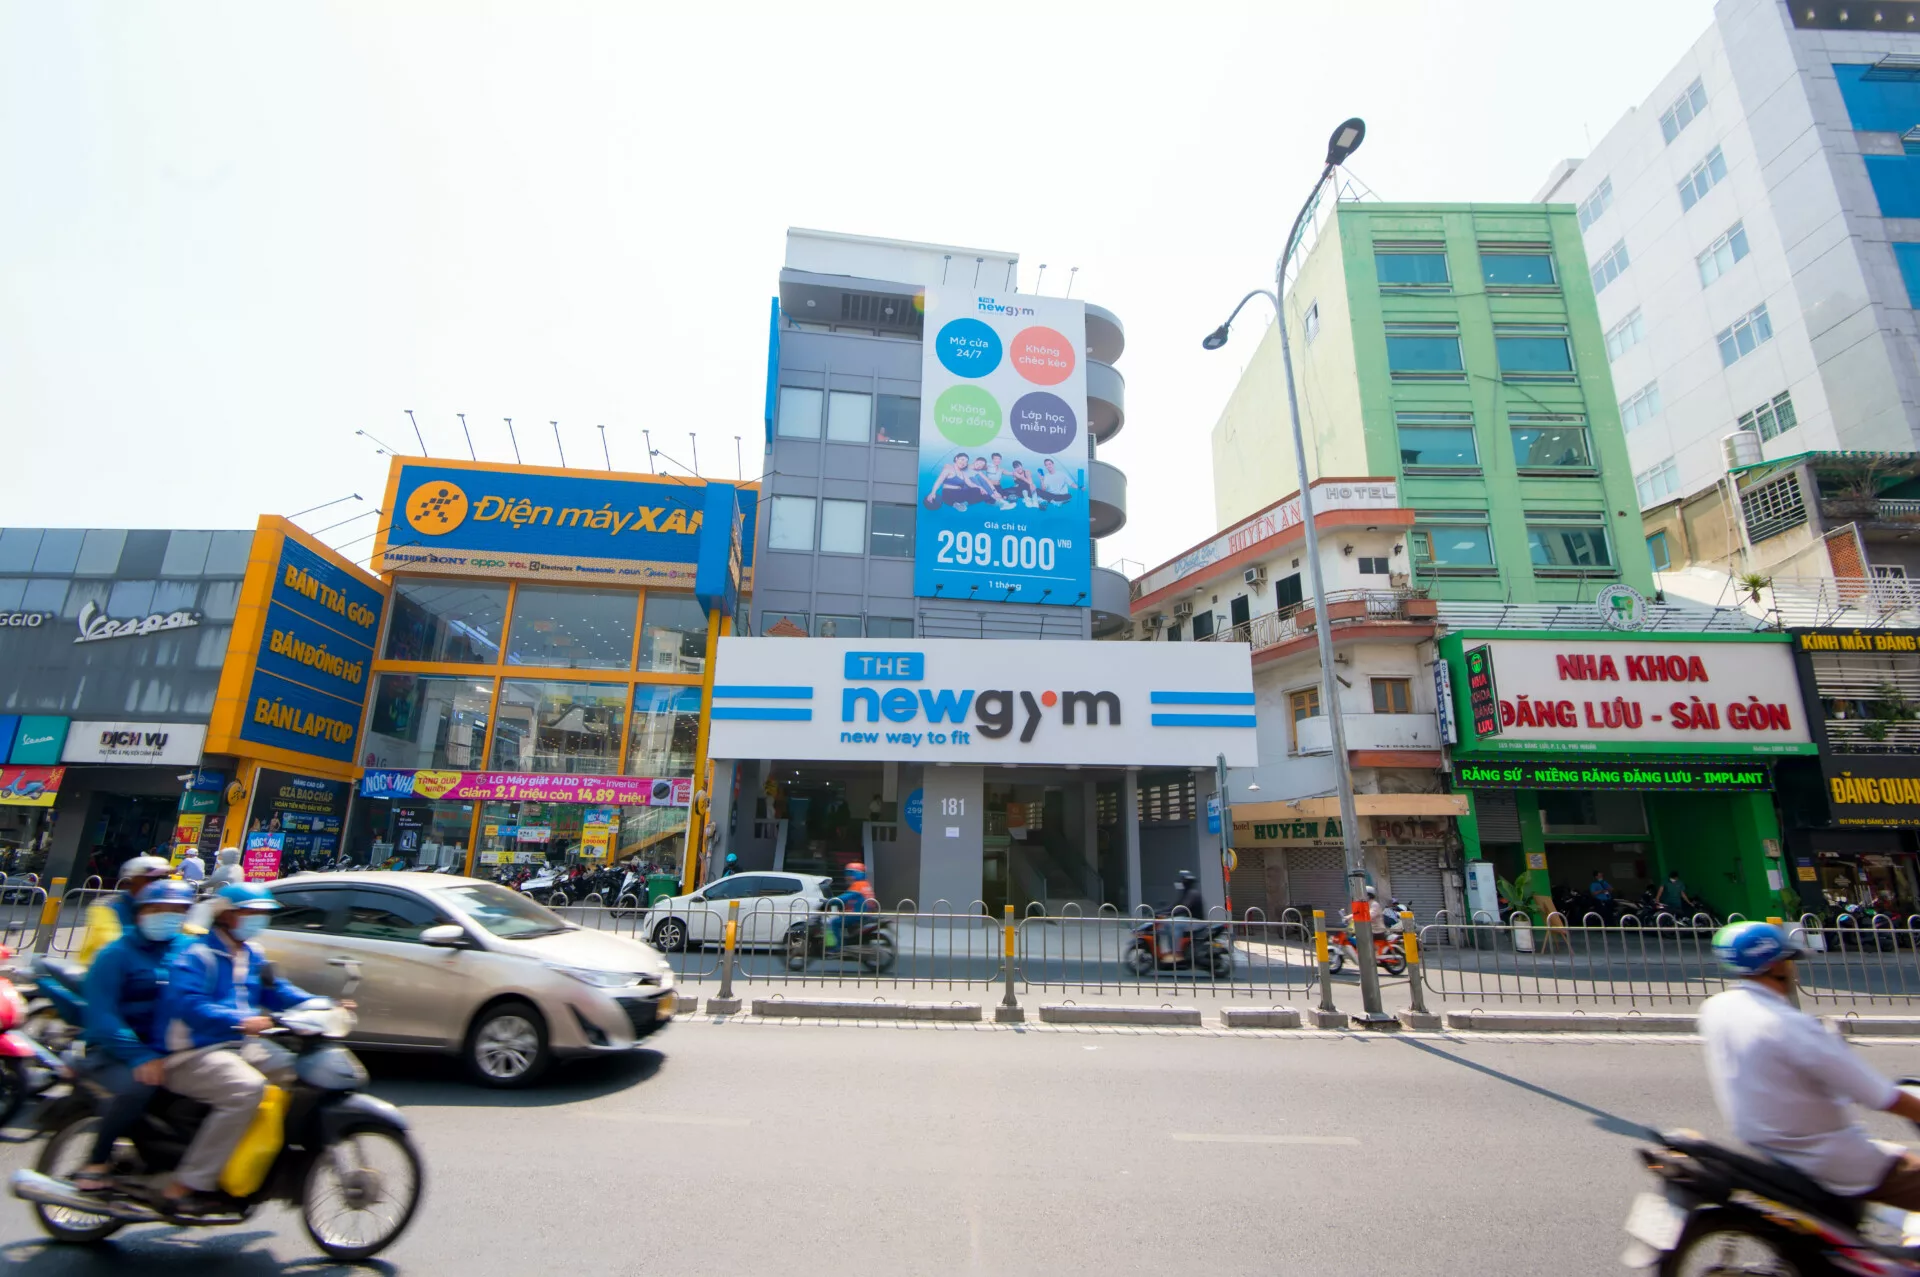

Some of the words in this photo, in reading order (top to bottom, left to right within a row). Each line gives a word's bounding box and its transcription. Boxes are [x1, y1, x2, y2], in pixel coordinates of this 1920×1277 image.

[950, 336, 966, 346] Mở
[969, 338, 989, 348] cửa
[1026, 344, 1060, 357] Không
[956, 348, 982, 359] 24/7
[950, 404, 986, 416] Không
[1022, 410, 1042, 421] Lớp
[1046, 412, 1065, 424] học
[1020, 421, 1047, 432] miễn
[1050, 424, 1066, 435] phí
[1326, 486, 1397, 500] HOTEL
[472, 494, 554, 530] Điện
[556, 503, 635, 536] máy
[629, 506, 704, 535] XA
[984, 521, 999, 530] Giá
[1002, 522, 1015, 530] chỉ
[937, 530, 1055, 571] 299.000
[1056, 538, 1072, 549] VNĐ
[384, 553, 428, 563] SAMSUNG
[429, 554, 468, 565] SONY
[470, 558, 506, 568] oppo
[541, 564, 573, 572] Electrolux
[576, 565, 616, 575] Panasonic
[618, 568, 640, 576] AQUA
[988, 580, 993, 588] 1
[994, 580, 1022, 592] tháng
[284, 564, 318, 600] BÁN
[320, 588, 348, 616] TRẢ
[348, 603, 375, 630] GÓP
[73, 600, 200, 643] Vespa
[269, 628, 304, 662] BÁN
[1800, 630, 1840, 650] KÍNH
[1840, 628, 1872, 650] MẮT
[1874, 632, 1917, 651] ĐĂNG
[858, 656, 911, 676] THE
[1556, 654, 1620, 682] NHA
[1625, 654, 1709, 682] KHOA
[1472, 674, 1488, 688] NHA
[1472, 688, 1491, 703] KHOA
[254, 696, 294, 730] BÁN
[292, 709, 354, 745] LAPTOP
[840, 686, 1122, 743] newgym
[1500, 694, 1578, 728] ĐĂNG
[1584, 696, 1644, 729] LƯU
[1669, 695, 1720, 730] SÀI
[1726, 695, 1792, 730] GÒN
[100, 731, 142, 748] DỊCH
[144, 732, 168, 750] VỤ
[840, 730, 880, 744] new
[885, 732, 923, 748] way
[927, 731, 948, 746] to
[950, 730, 970, 746] fit
[366, 772, 387, 792] NÓC
[489, 775, 502, 785] LG
[506, 776, 528, 786] Máy
[528, 776, 550, 787] giặt
[564, 777, 579, 786] DD
[606, 780, 639, 788] Inverter
[1462, 766, 1500, 781] RĂNG
[1503, 766, 1523, 781] SỨ
[1582, 768, 1621, 783] RĂNG
[1623, 768, 1662, 783] ĐĂNG
[1664, 770, 1692, 784] LƯU
[1704, 772, 1764, 784] IMPLANT
[459, 785, 490, 798] Giảm
[494, 785, 516, 799] 2,1
[519, 788, 548, 800] triệu
[549, 790, 572, 800] còn
[577, 788, 616, 803] 14,89
[618, 791, 647, 806] triệu
[1831, 771, 1880, 804] ĐĂNG
[940, 797, 966, 816] 181
[1233, 821, 1250, 831] hotel
[1324, 816, 1344, 838] Â
[251, 837, 264, 848] NÓC
